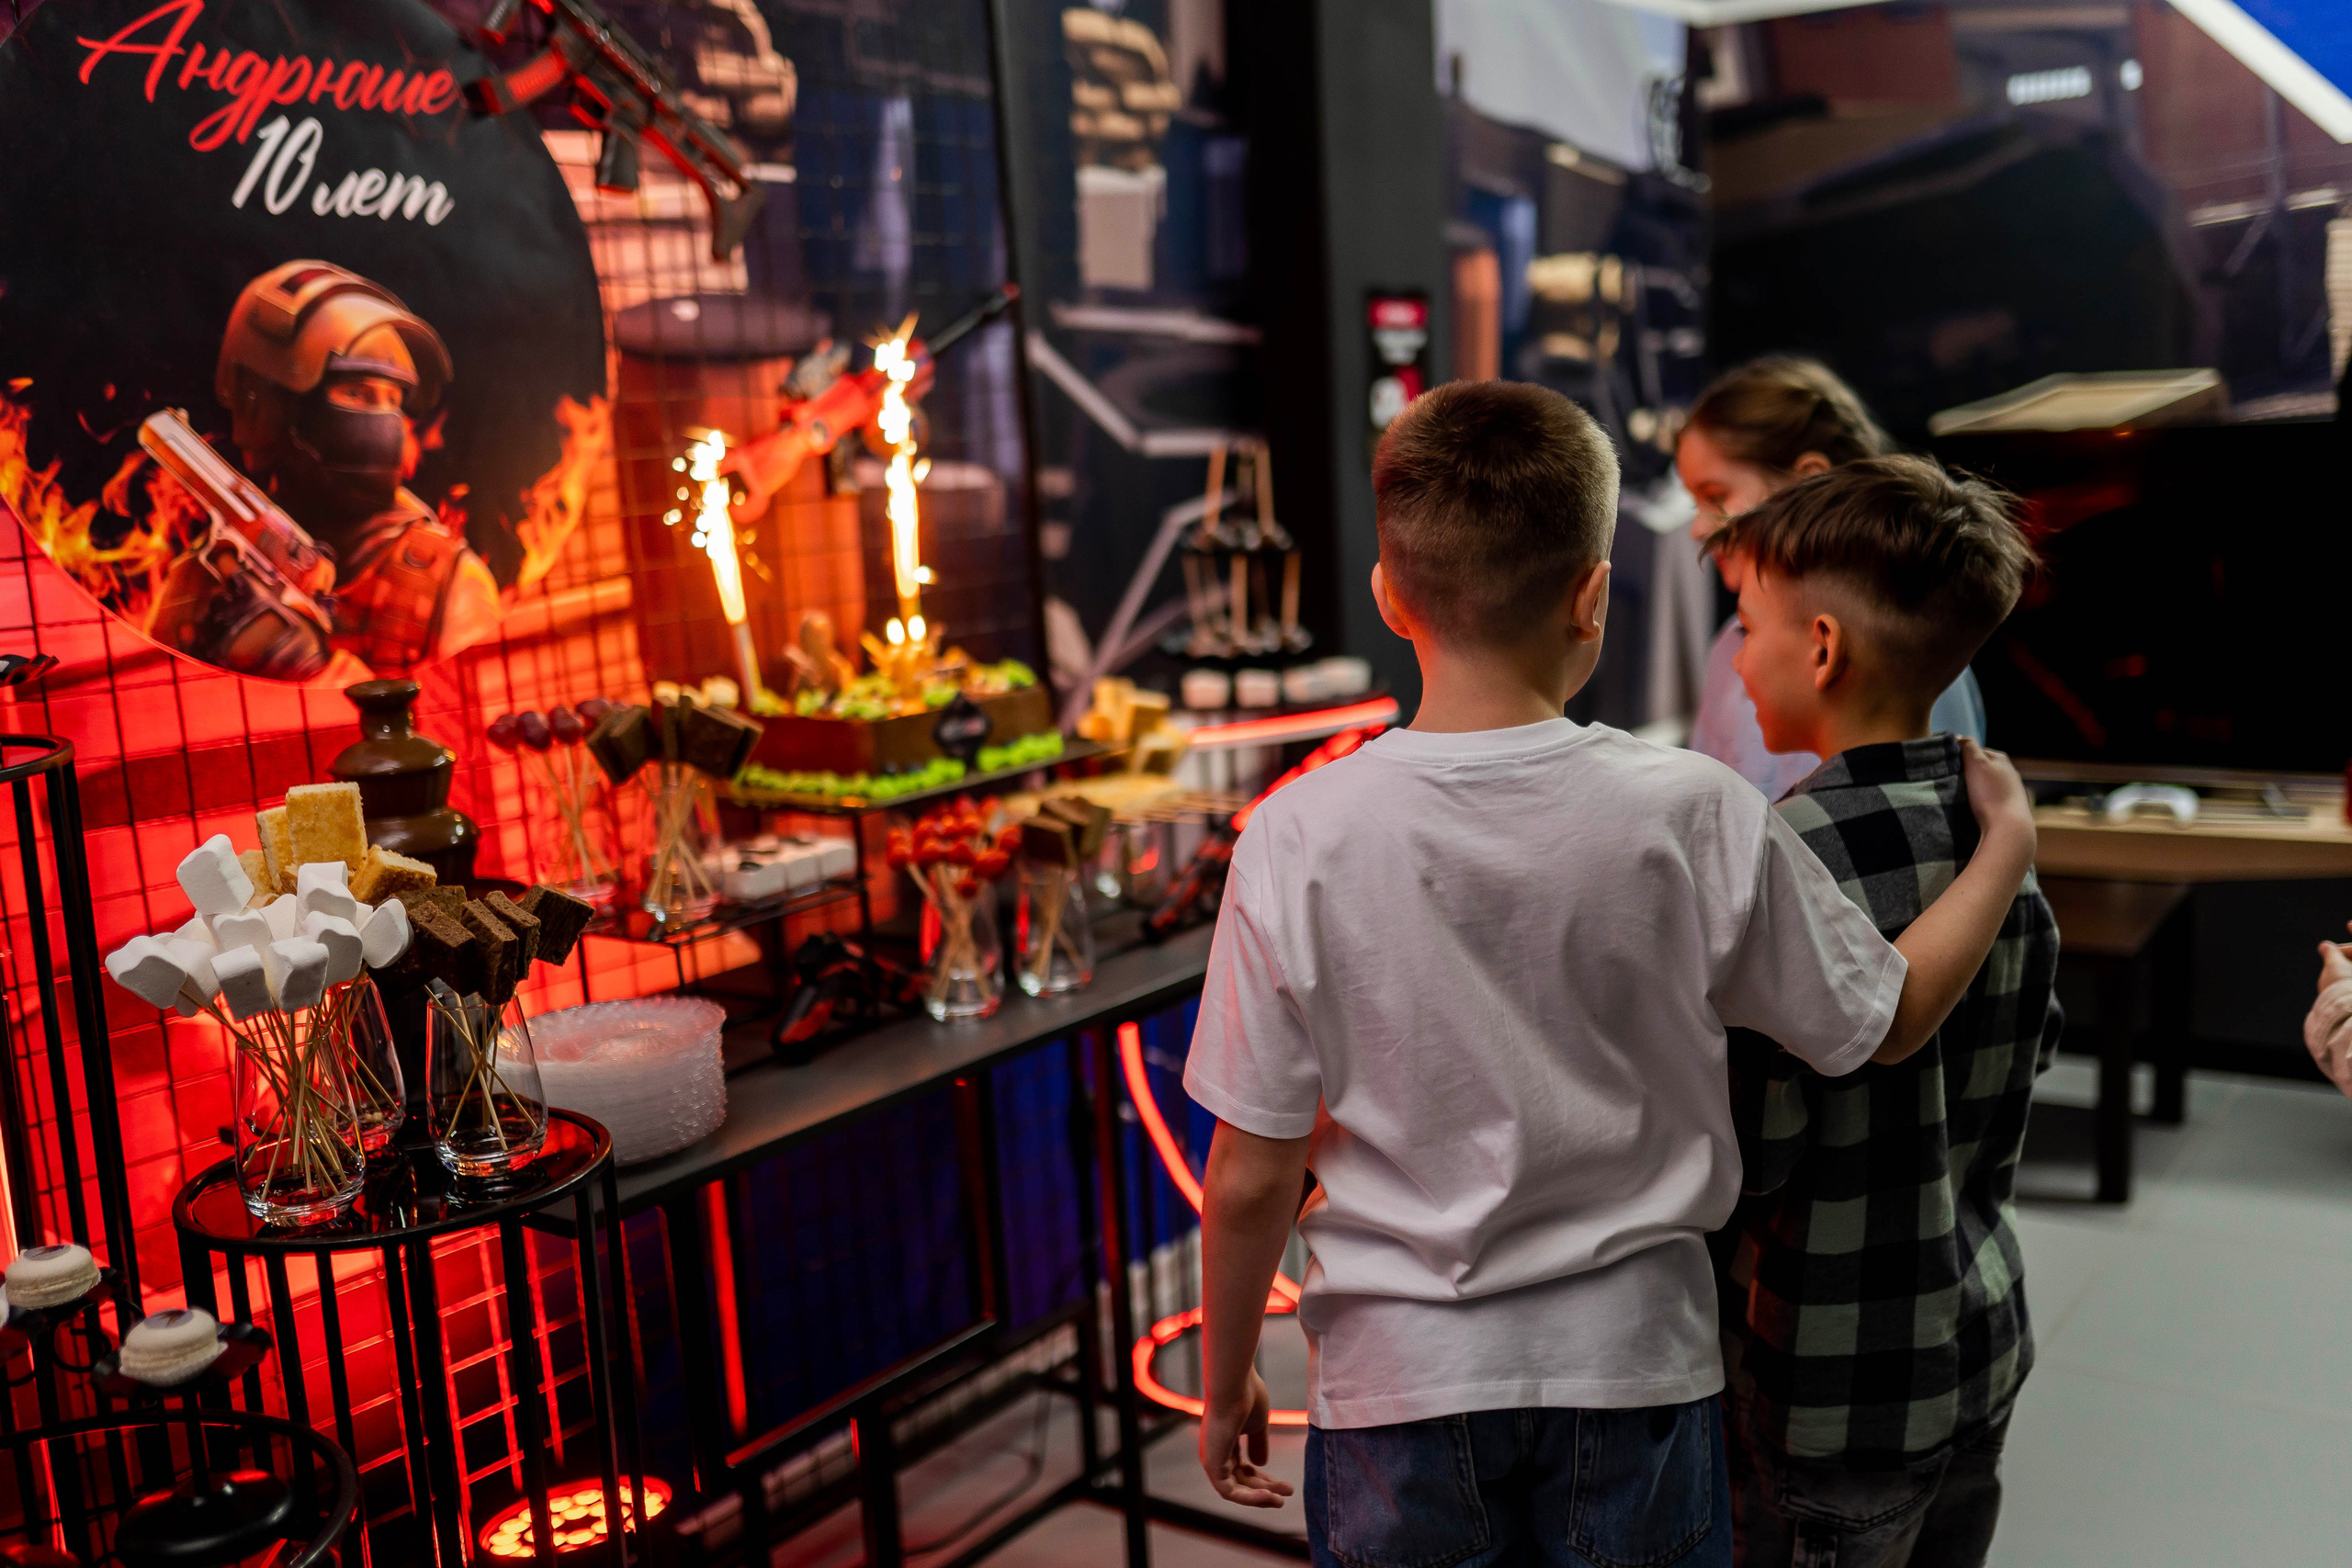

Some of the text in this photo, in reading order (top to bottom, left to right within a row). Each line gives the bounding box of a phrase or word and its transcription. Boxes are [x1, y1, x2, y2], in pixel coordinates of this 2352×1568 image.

[75, 0, 459, 152] Андрюше
[232, 115, 456, 226] 10 лет
